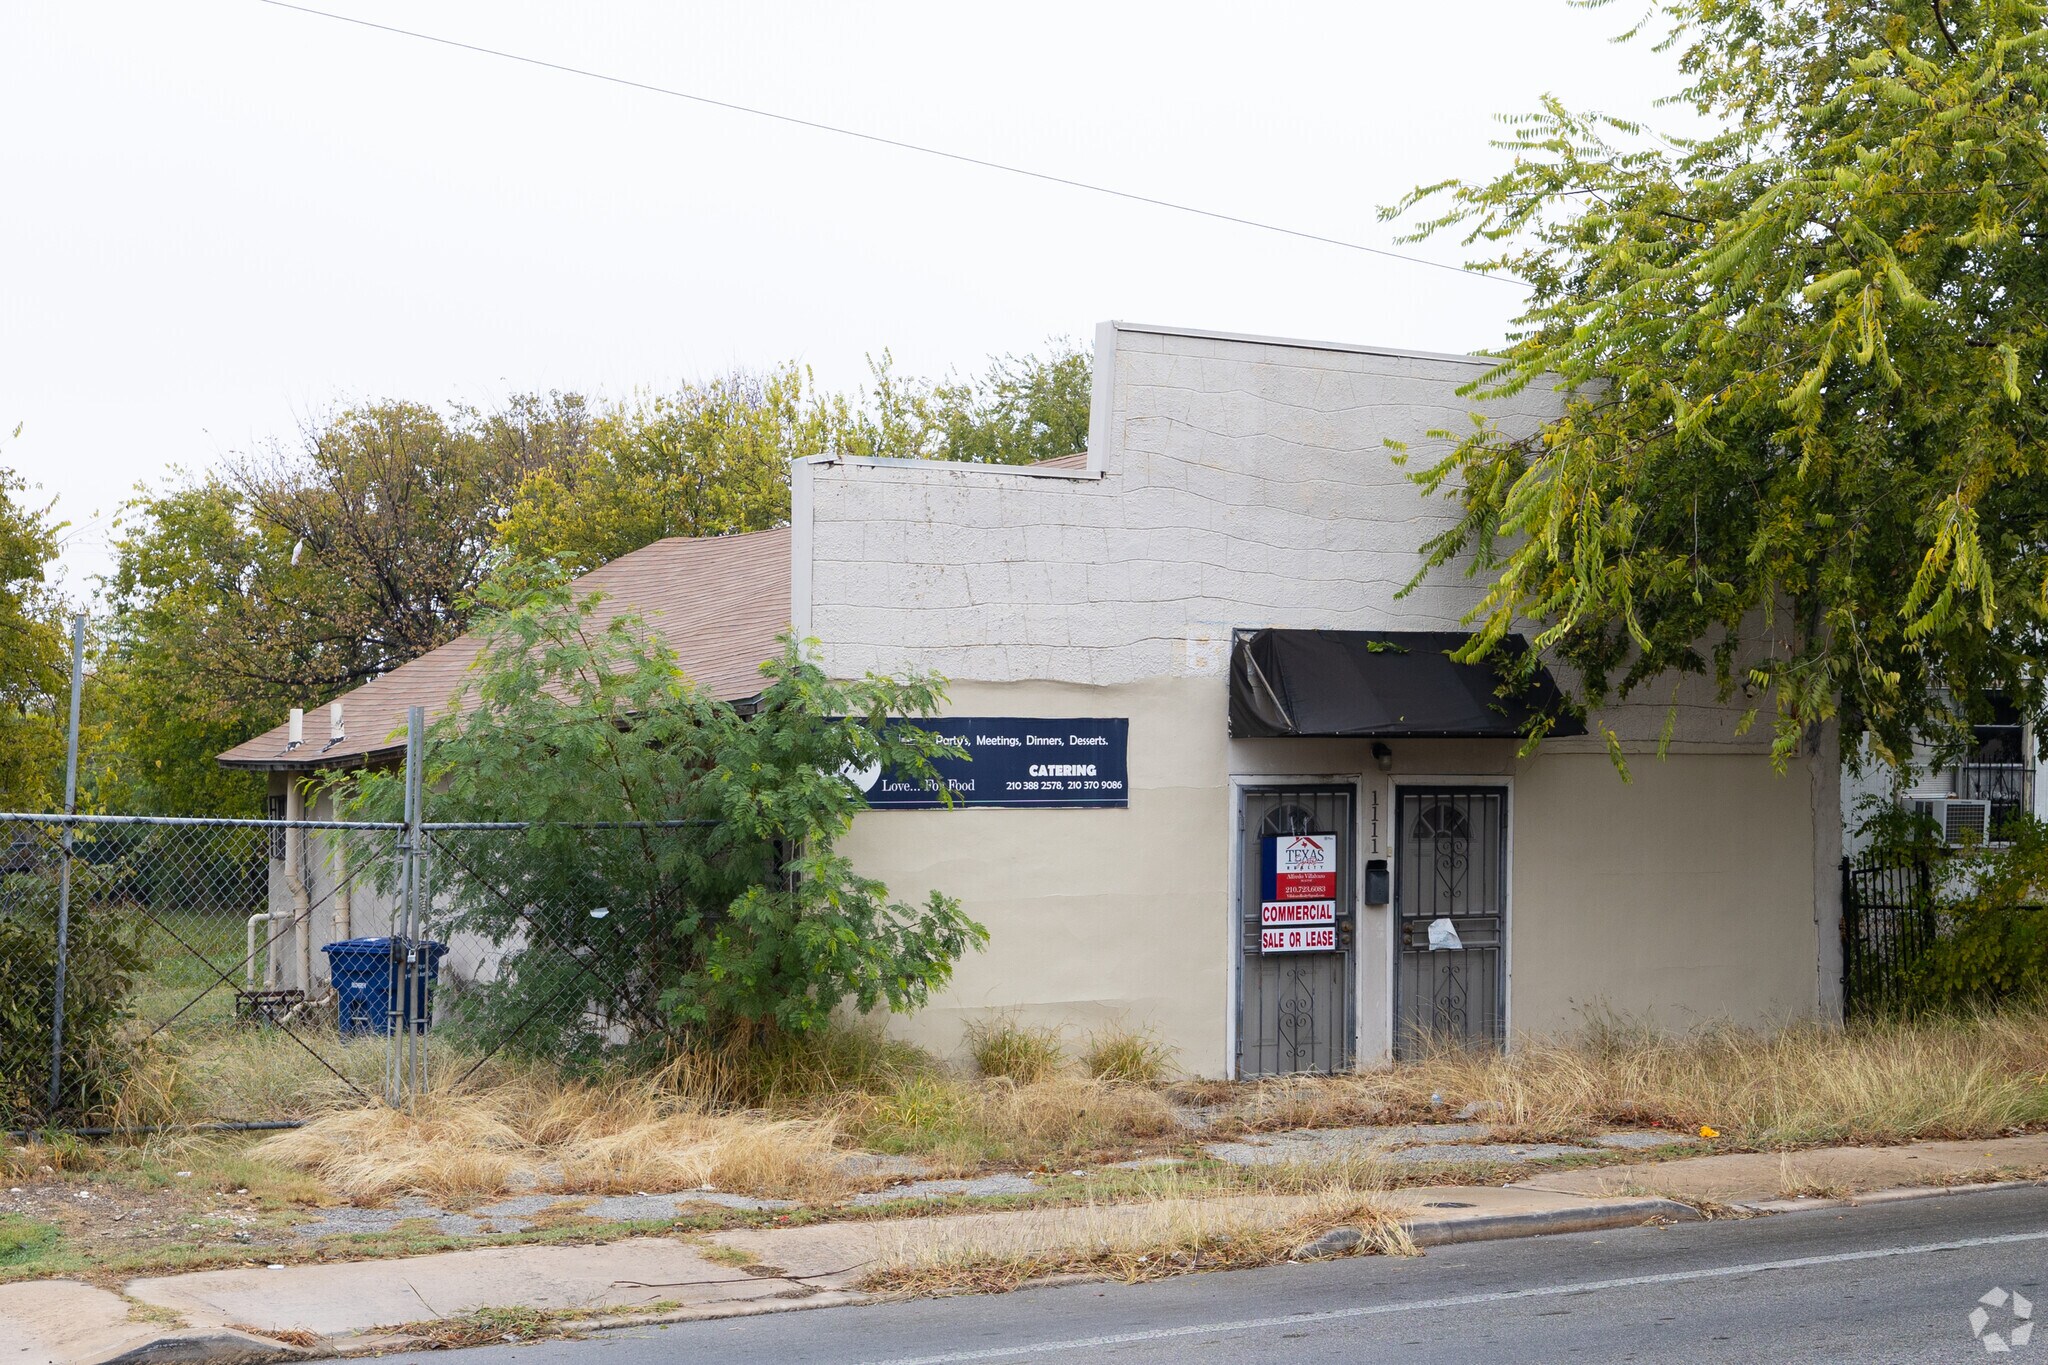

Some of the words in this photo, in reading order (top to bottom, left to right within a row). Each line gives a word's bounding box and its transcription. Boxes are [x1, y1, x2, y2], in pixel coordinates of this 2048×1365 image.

[976, 735, 1021, 747] Meetings,
[1026, 735, 1065, 747] Dinners,
[1069, 735, 1109, 746] Desserts.
[1028, 764, 1097, 777] CATERING
[881, 779, 920, 791] Love...
[924, 779, 945, 791] Fo
[947, 779, 975, 791] Food
[1006, 781, 1022, 790] 210
[1023, 781, 1039, 790] 388
[1041, 781, 1064, 791] 2578,
[1067, 781, 1082, 790] 210
[1084, 781, 1099, 790] 370
[1101, 781, 1123, 789] 9086
[1371, 791, 1379, 854] 1111
[1285, 849, 1324, 862] TEXAS
[1263, 904, 1332, 922] COMMERCIAL
[1262, 932, 1284, 949] SALE
[1289, 931, 1301, 948] OR
[1306, 931, 1333, 947] LEASE
